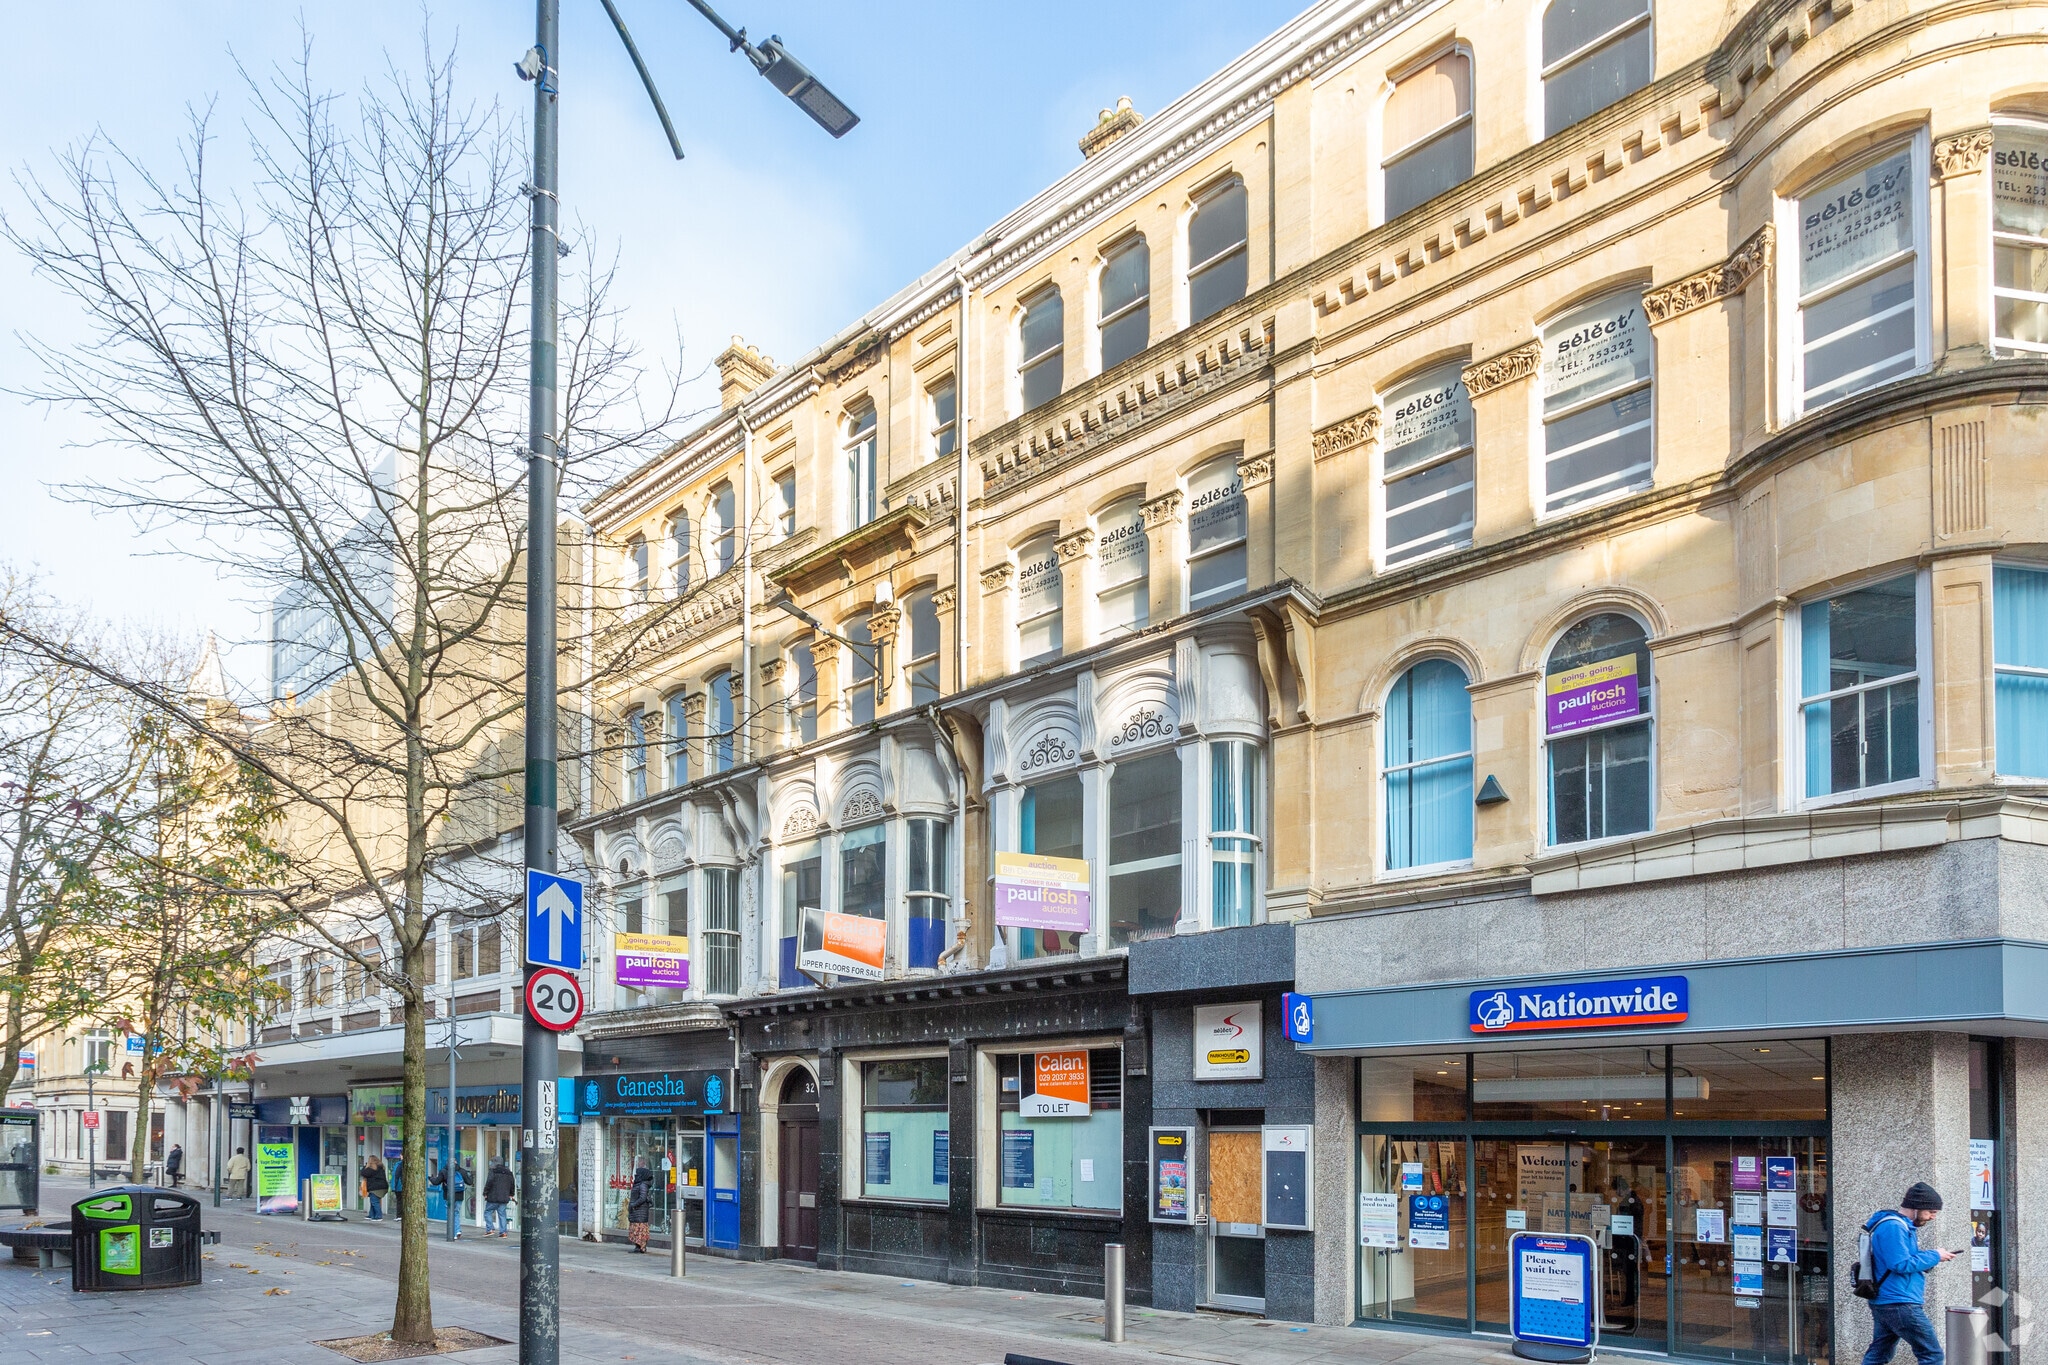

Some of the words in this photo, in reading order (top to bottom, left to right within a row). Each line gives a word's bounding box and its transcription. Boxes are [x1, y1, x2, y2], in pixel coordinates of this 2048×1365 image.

[1997, 180, 2021, 192] TEL:
[1805, 223, 1834, 240] SELECT
[1836, 187, 1905, 224] APPOINTMENTS
[1808, 233, 1838, 252] TEL:
[1844, 200, 1902, 236] 253322
[1805, 212, 1905, 262] www.select.co.uk
[1582, 326, 1636, 352] APPOINTMENTS
[1560, 360, 1584, 373] TEL:
[1588, 338, 1633, 362] 253322
[1558, 347, 1635, 382] www.select.co.uk
[1396, 426, 1416, 438] TEL:
[1420, 408, 1458, 430] 253322
[1395, 417, 1459, 446] www.select.co.uk
[1192, 515, 1208, 526] TEL:
[1210, 502, 1240, 519] 253322
[1102, 552, 1116, 562] TEL:
[1118, 540, 1144, 556] 253322
[1036, 574, 1058, 589] 253322
[1572, 674, 1605, 688] December
[1606, 670, 1623, 681] 2020
[1558, 684, 1626, 714] paulfosh
[1590, 698, 1626, 712] auctions
[1028, 861, 1058, 870] auction
[1002, 866, 1016, 874] 8th
[1017, 868, 1057, 879] December
[1058, 872, 1077, 881] 2020
[1020, 878, 1045, 887] FORMER
[1007, 886, 1078, 905] paulfosh
[1042, 904, 1078, 915] auctions
[827, 932, 842, 941] 029
[626, 957, 680, 970] paulfosh
[802, 959, 824, 970] UPPER
[824, 962, 850, 974] FLOORS
[852, 966, 864, 976] FOR
[866, 968, 883, 978] SALE
[652, 968, 680, 976] auctions
[536, 984, 576, 1013] 20
[1519, 986, 1678, 1019] Nationwide
[1038, 1074, 1050, 1082] 029
[1052, 1073, 1068, 1081] 2037
[1068, 1072, 1084, 1080] 3933
[616, 1074, 685, 1096] Ganesha
[806, 1082, 815, 1093] 32
[432, 1090, 449, 1114] The
[1037, 1104, 1050, 1114] TO
[1052, 1103, 1070, 1113] LET
[290, 1106, 310, 1116] HALIFAX
[524, 1133, 532, 1144] A
[263, 1146, 288, 1157] Vape
[1521, 1156, 1578, 1167] Welcome
[1526, 1254, 1556, 1264] Please
[1526, 1266, 1546, 1274] wait
[1548, 1266, 1570, 1276] here
